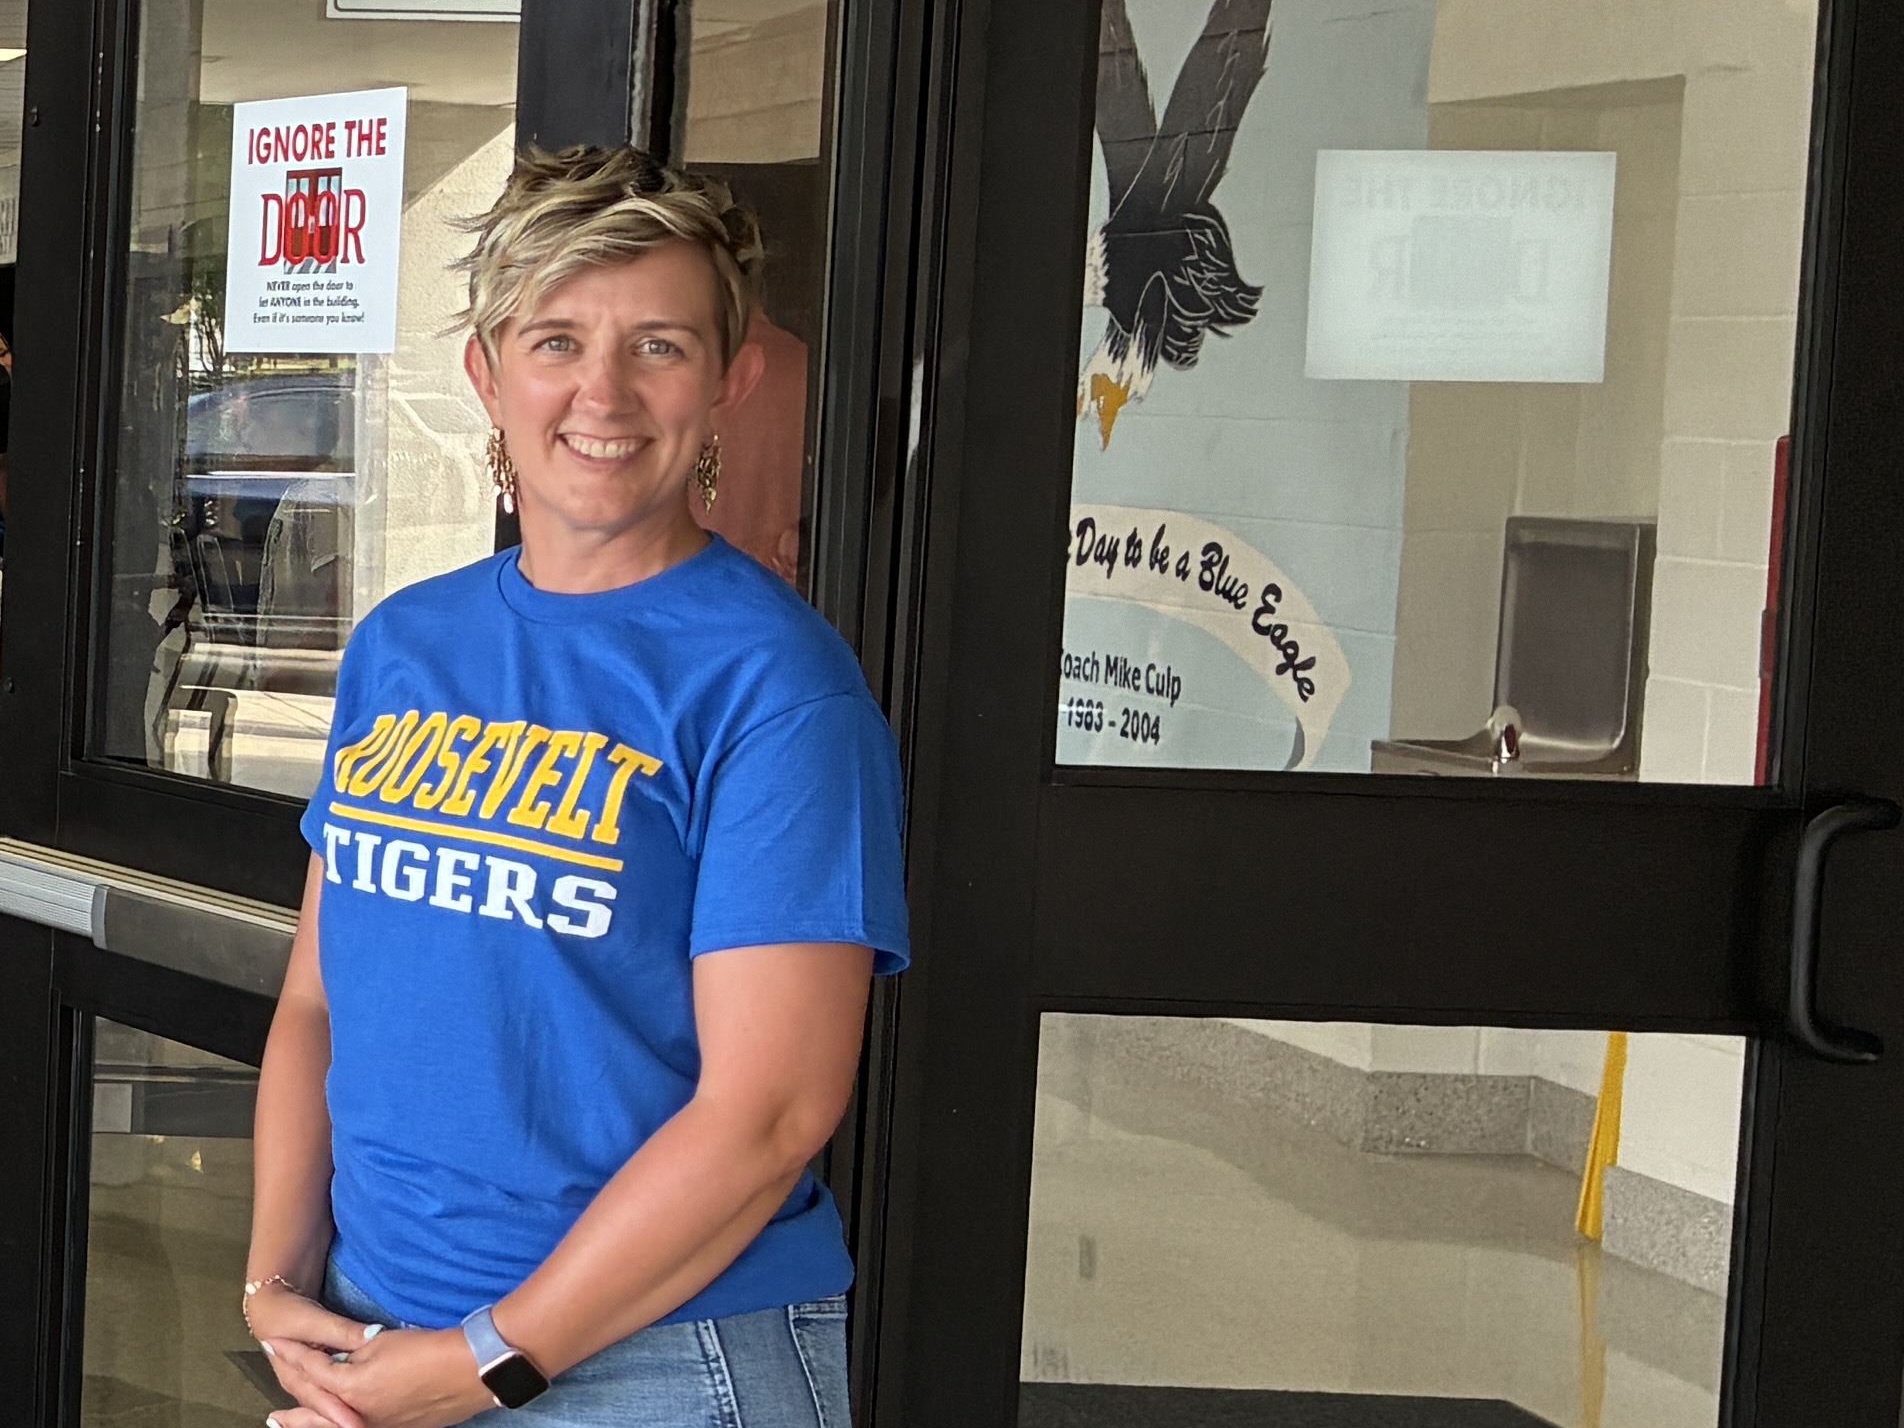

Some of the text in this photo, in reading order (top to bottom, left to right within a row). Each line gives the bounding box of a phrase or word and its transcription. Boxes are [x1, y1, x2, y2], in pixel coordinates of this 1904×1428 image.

[248, 117, 387, 165] IGNORE THE
[257, 188, 367, 266] DOOR
[270, 296, 301, 307] ANYONE
[312, 296, 324, 307] the
[291, 283, 310, 293] open
[312, 280, 324, 291] the
[326, 279, 344, 291] door
[345, 280, 354, 290] to
[253, 312, 270, 324] Even
[326, 315, 340, 326] you
[1075, 516, 1120, 579] Day
[1124, 527, 1143, 569] to
[1149, 523, 1170, 575] be
[1175, 550, 1193, 582] a
[1198, 542, 1249, 610] Blue
[1251, 582, 1316, 703] Eagle
[1104, 654, 1141, 695] Mike
[1145, 662, 1182, 708] Culp
[1067, 696, 1104, 733] 1983
[1119, 707, 1161, 746] 2004
[334, 709, 664, 845] ROOSEVELT
[323, 822, 618, 939] TIGERS
